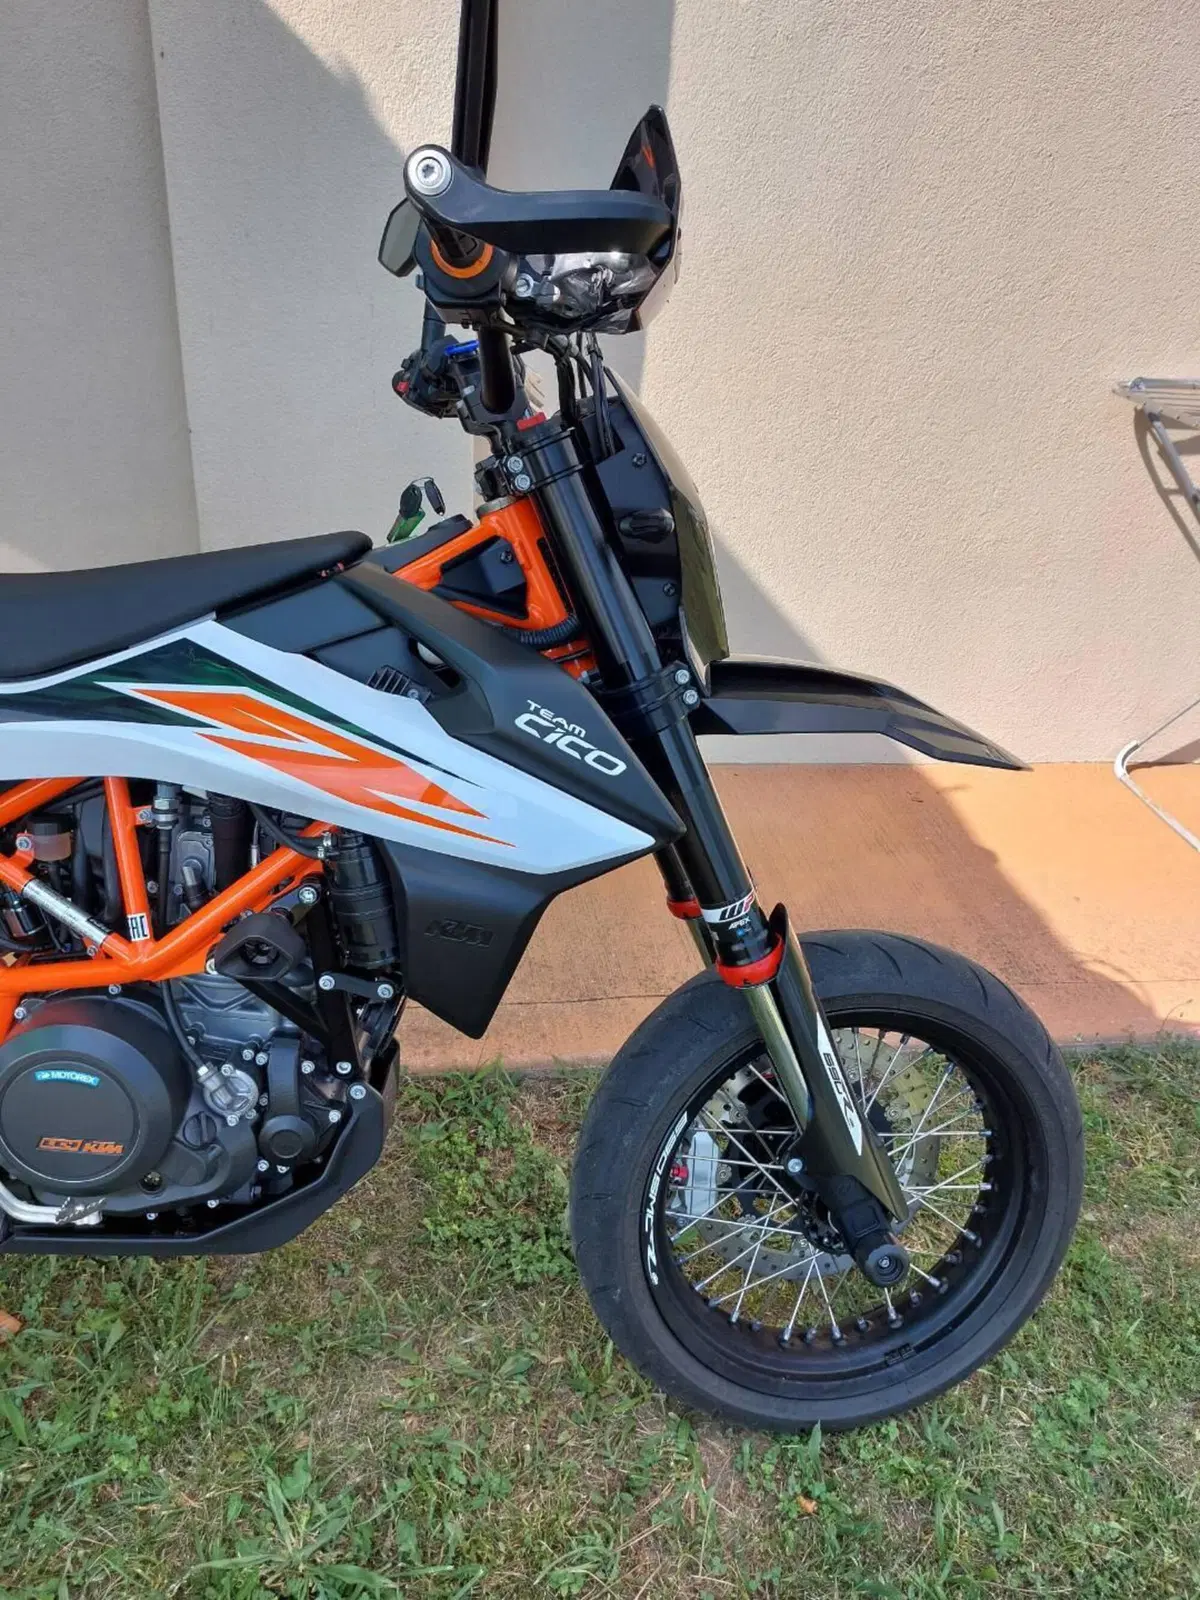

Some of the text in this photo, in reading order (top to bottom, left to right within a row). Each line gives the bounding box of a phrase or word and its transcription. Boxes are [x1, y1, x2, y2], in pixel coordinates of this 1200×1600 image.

[526, 699, 587, 738] TEAM
[424, 917, 496, 948] KTM
[50, 1070, 96, 1086] MOTOREX
